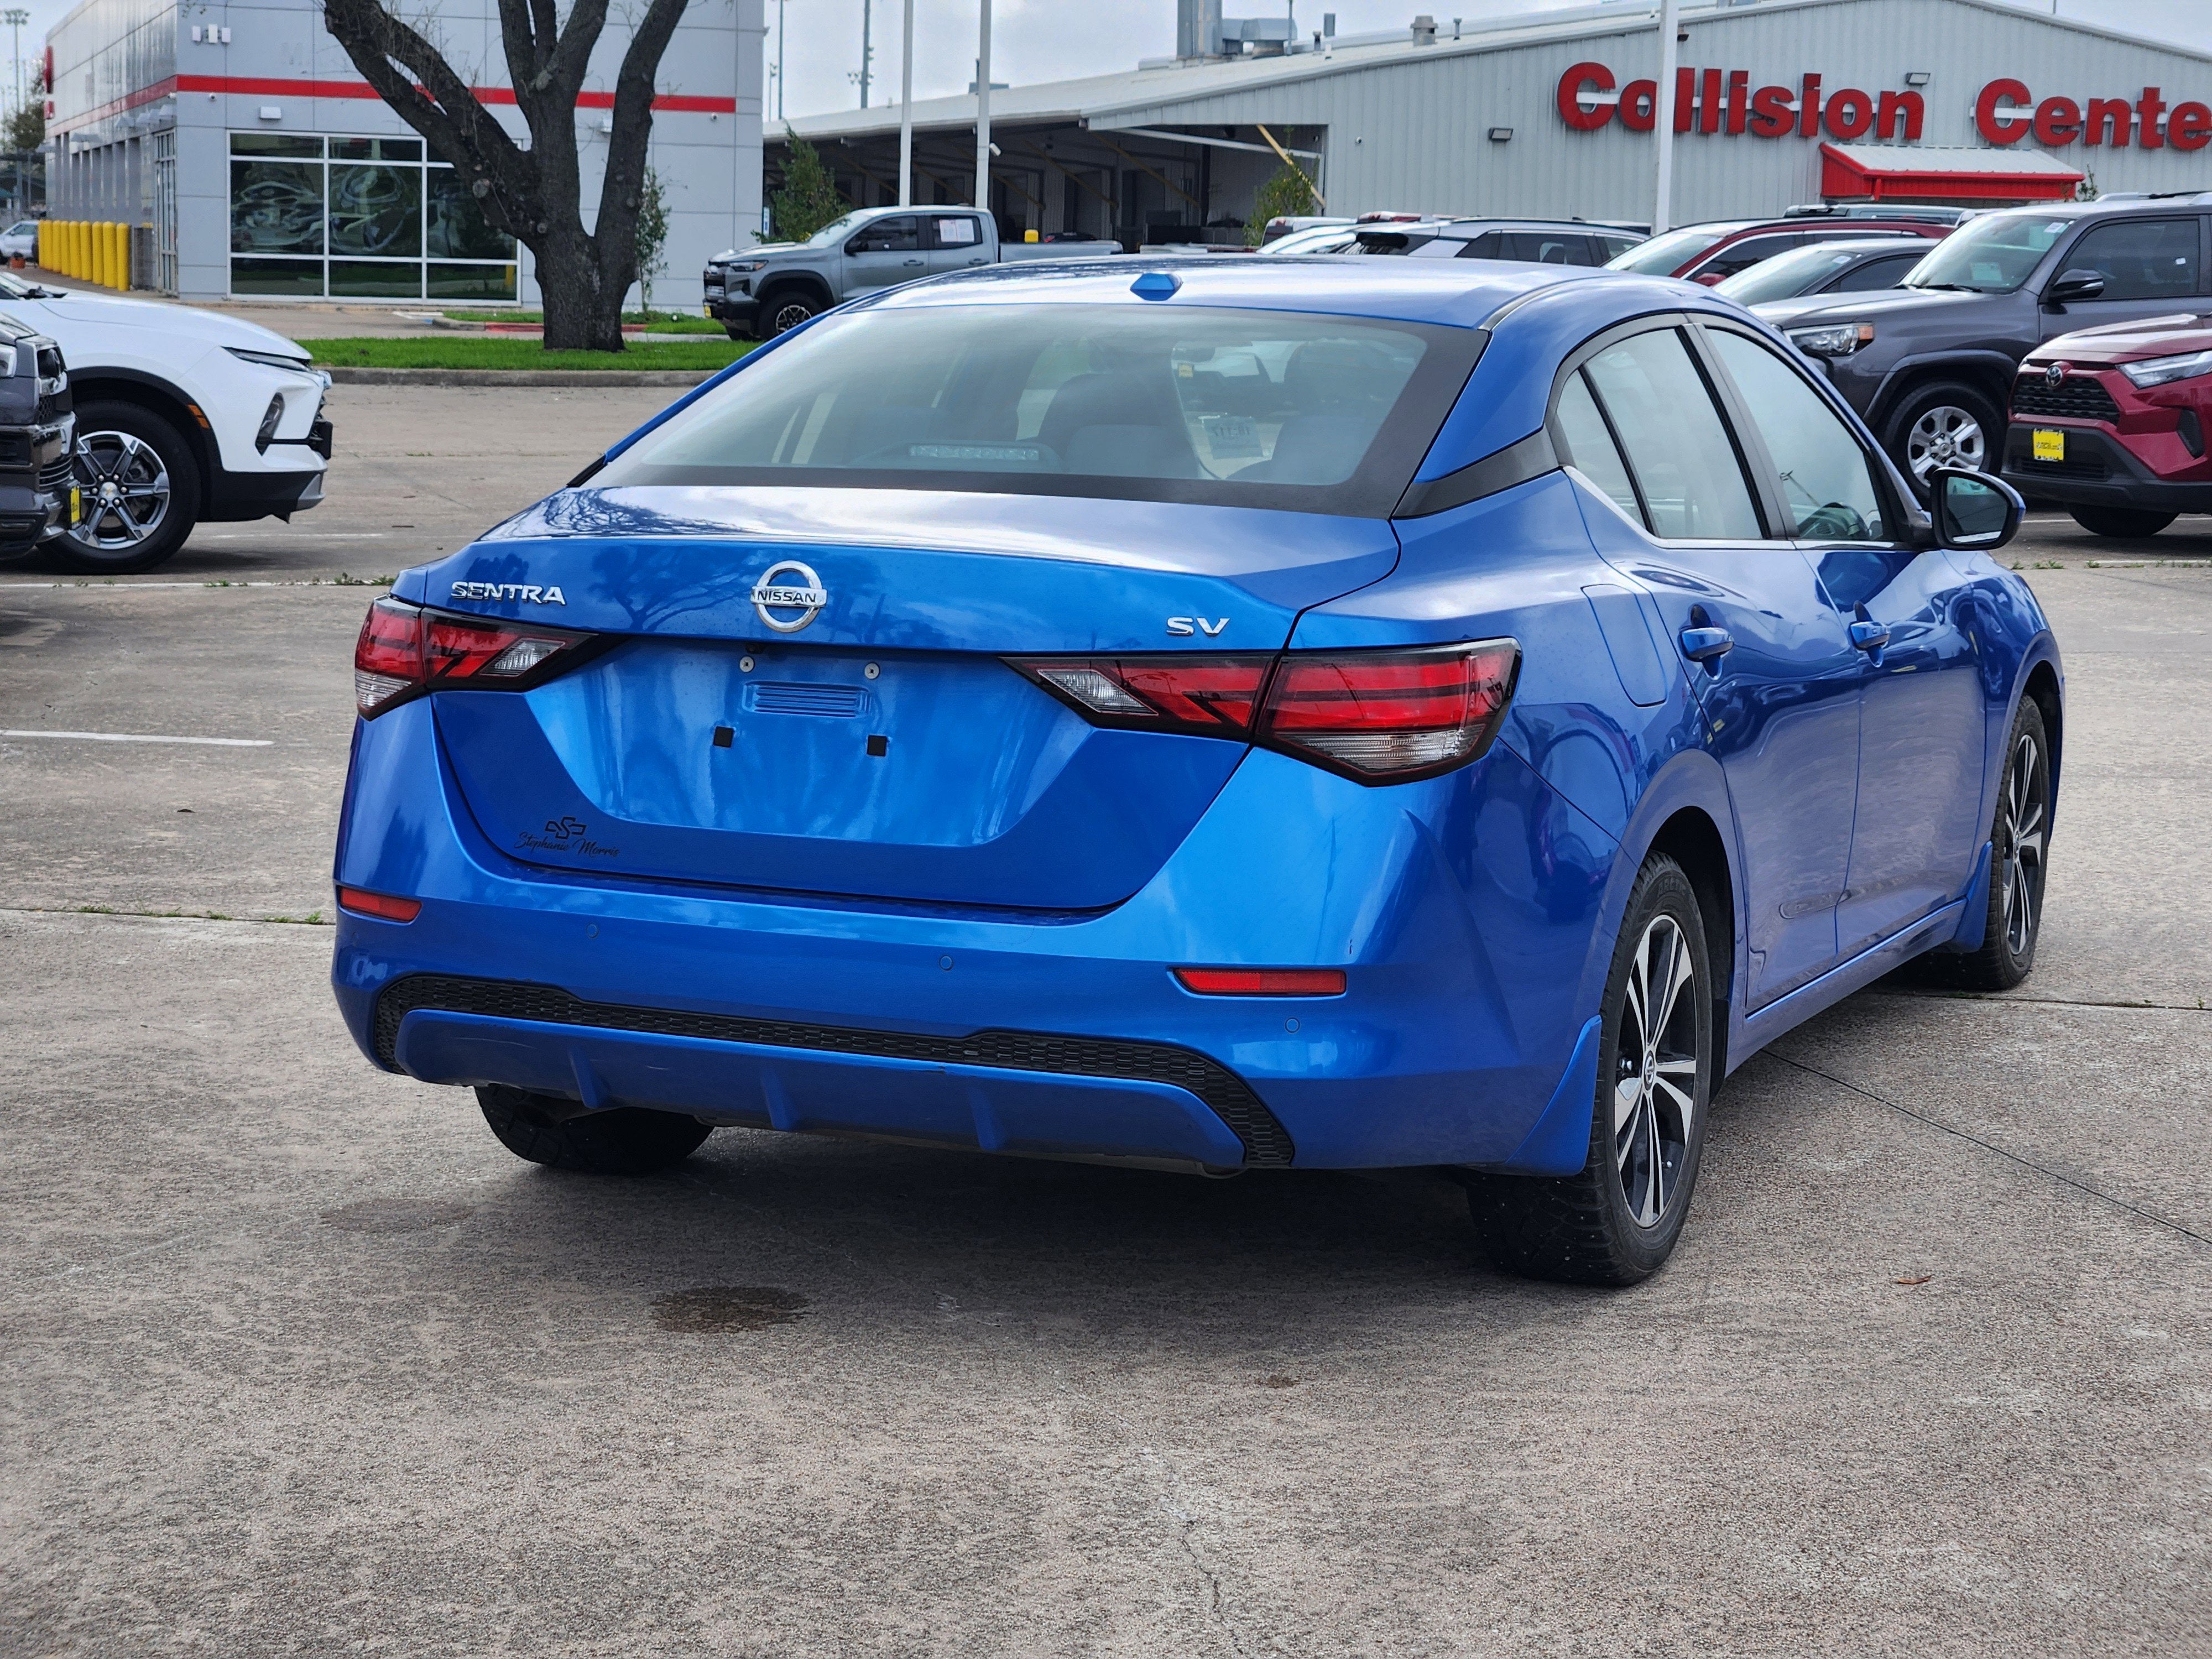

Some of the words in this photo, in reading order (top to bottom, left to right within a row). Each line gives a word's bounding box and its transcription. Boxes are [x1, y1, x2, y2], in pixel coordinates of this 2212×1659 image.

[1556, 61, 1925, 140] Collision
[1976, 77, 2212, 150] Cente
[451, 581, 567, 606] SENTRA
[757, 589, 817, 603] NISSAN
[1166, 617, 1230, 636] SV
